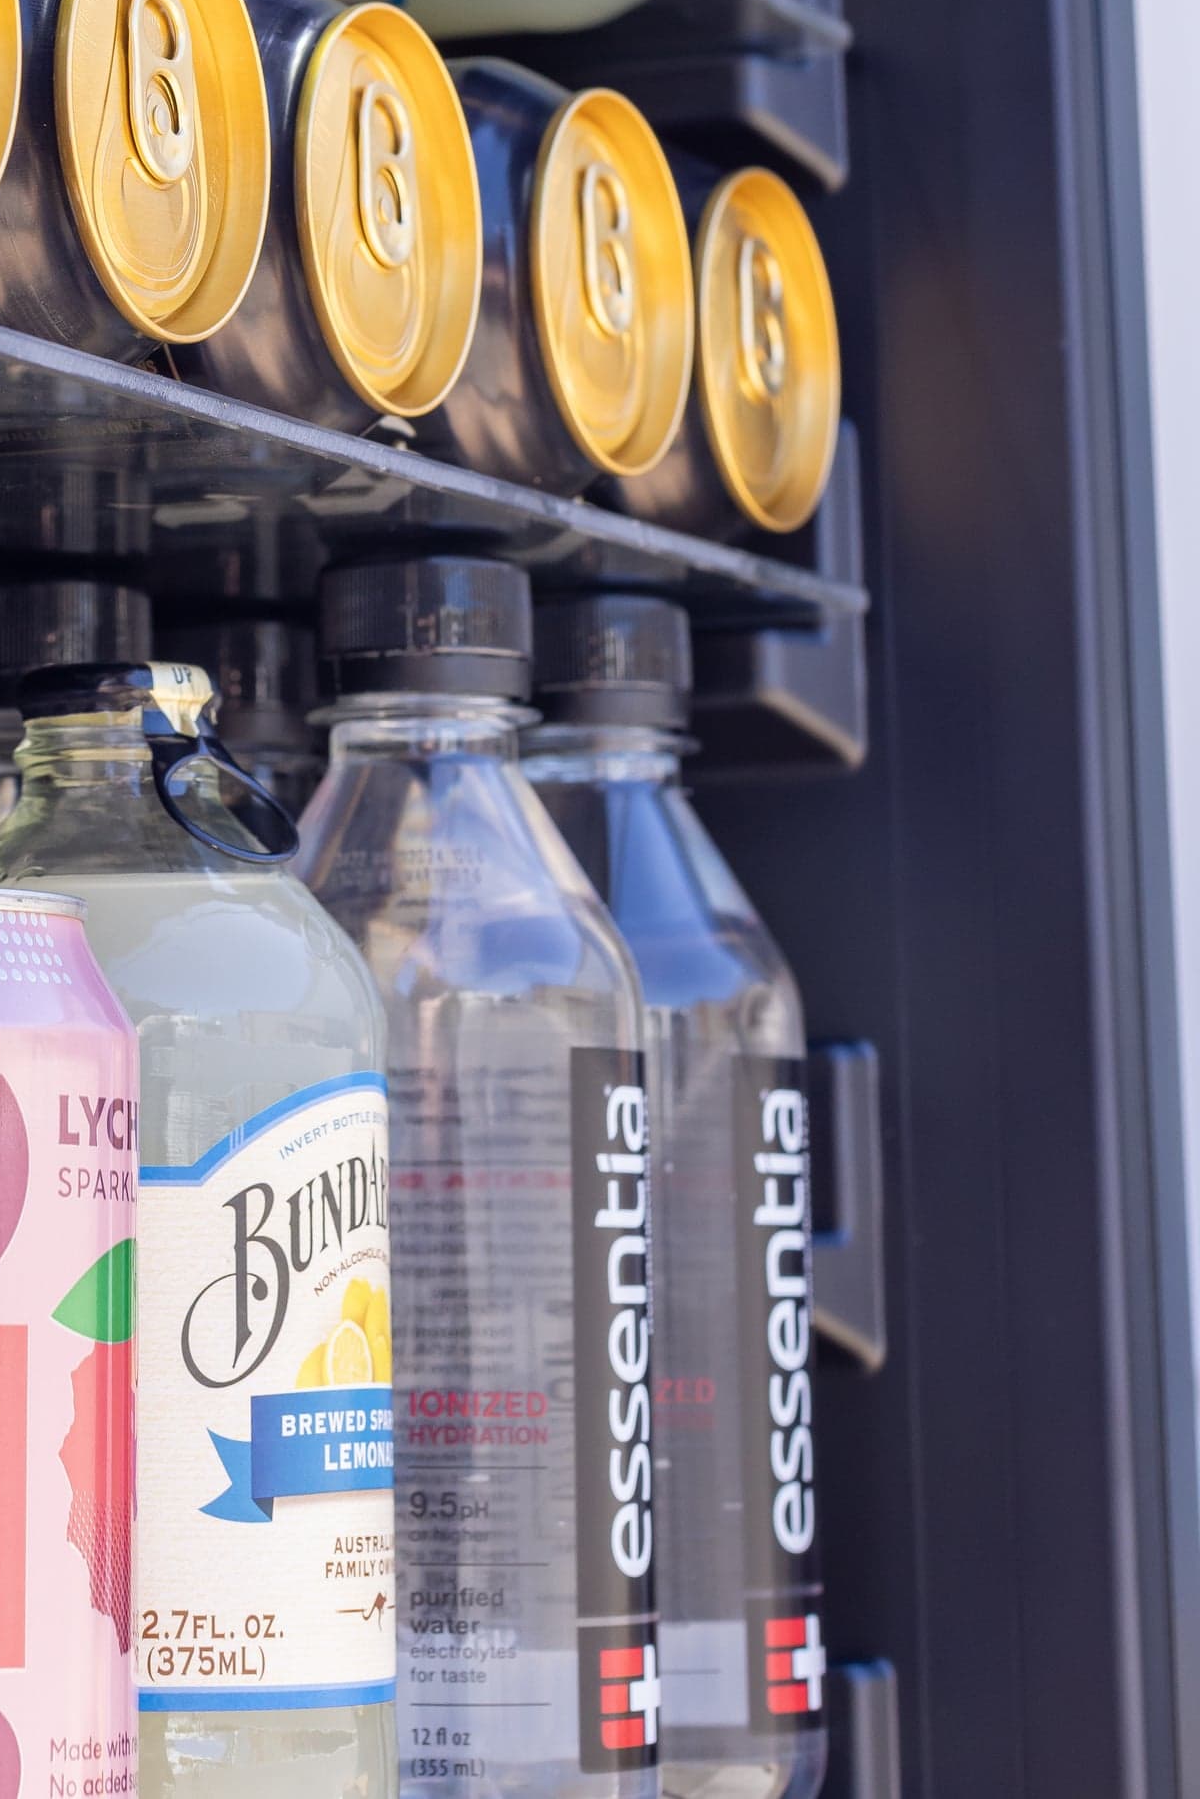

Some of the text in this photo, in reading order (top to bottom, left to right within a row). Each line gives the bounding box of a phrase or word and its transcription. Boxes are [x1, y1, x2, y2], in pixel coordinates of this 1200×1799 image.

[58, 1094, 138, 1151] LYCH
[279, 1123, 328, 1160] INVERT
[333, 1110, 371, 1131] BOTTLE
[58, 1167, 138, 1204] SPARKL
[181, 1131, 388, 1389] BUNDA
[594, 1084, 653, 1579] essentia
[753, 1087, 816, 1554] essentia
[409, 1390, 548, 1419] IONIZED
[281, 1409, 367, 1437] BREWED
[408, 1426, 548, 1446] HYDRATION
[324, 1440, 394, 1471] LEMONA
[334, 1536, 394, 1555] AUSTRAL
[325, 1562, 376, 1579] FAMILY
[410, 1588, 505, 1610] purified
[140, 1609, 285, 1640] 2.7FL. OZ.
[411, 1618, 481, 1635] water
[411, 1644, 518, 1663] electrolytes
[411, 1666, 488, 1684] for taste
[49, 1736, 102, 1761] Made
[107, 1731, 131, 1758] with
[412, 1727, 432, 1746] 12
[451, 1731, 472, 1746] oz
[411, 1757, 486, 1778] (355 mL)
[49, 1772, 77, 1799] No
[83, 1766, 128, 1796] added
